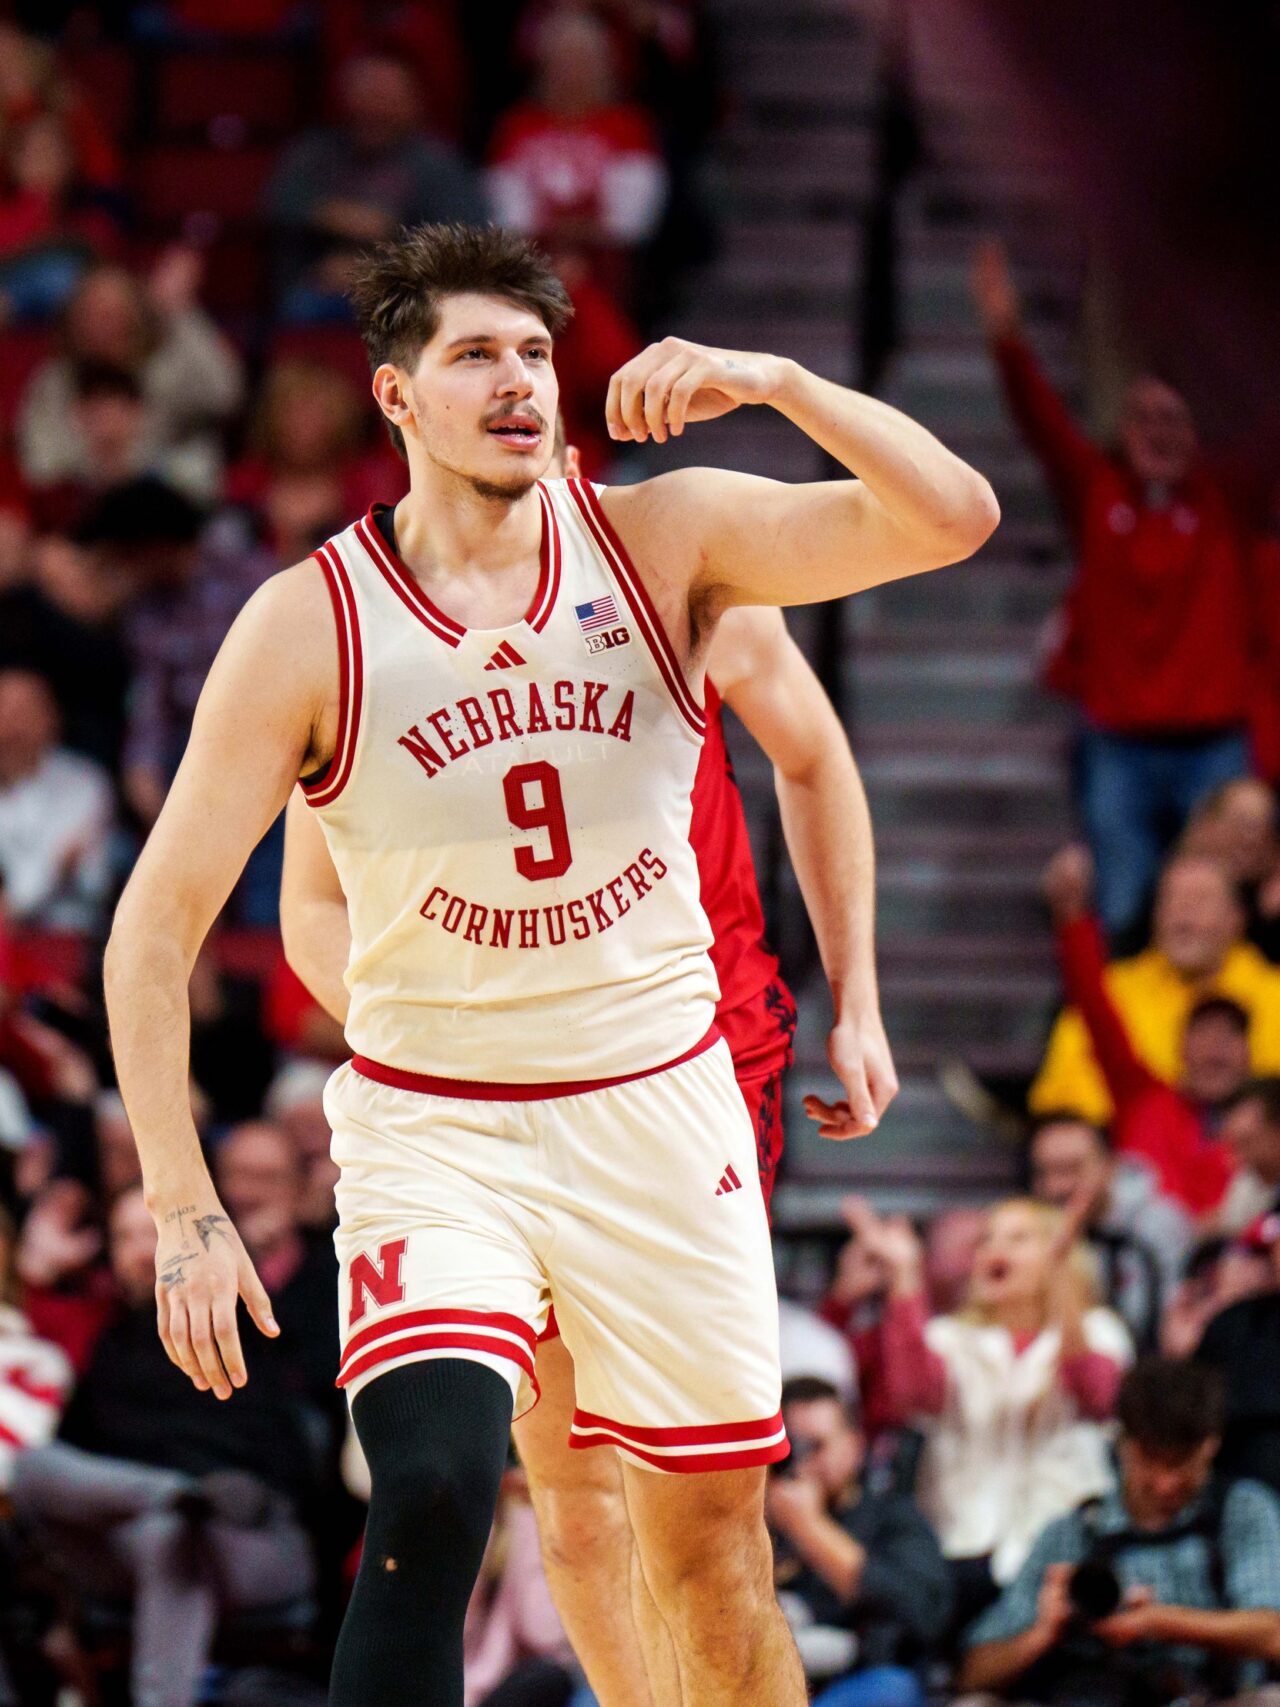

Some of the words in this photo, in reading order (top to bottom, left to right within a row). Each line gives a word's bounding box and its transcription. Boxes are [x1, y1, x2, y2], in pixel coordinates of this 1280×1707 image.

[397, 681, 635, 779] NEBRASKA
[502, 760, 573, 882] 9
[419, 848, 668, 949] CORNHUSKERS
[348, 1236, 408, 1330] N
